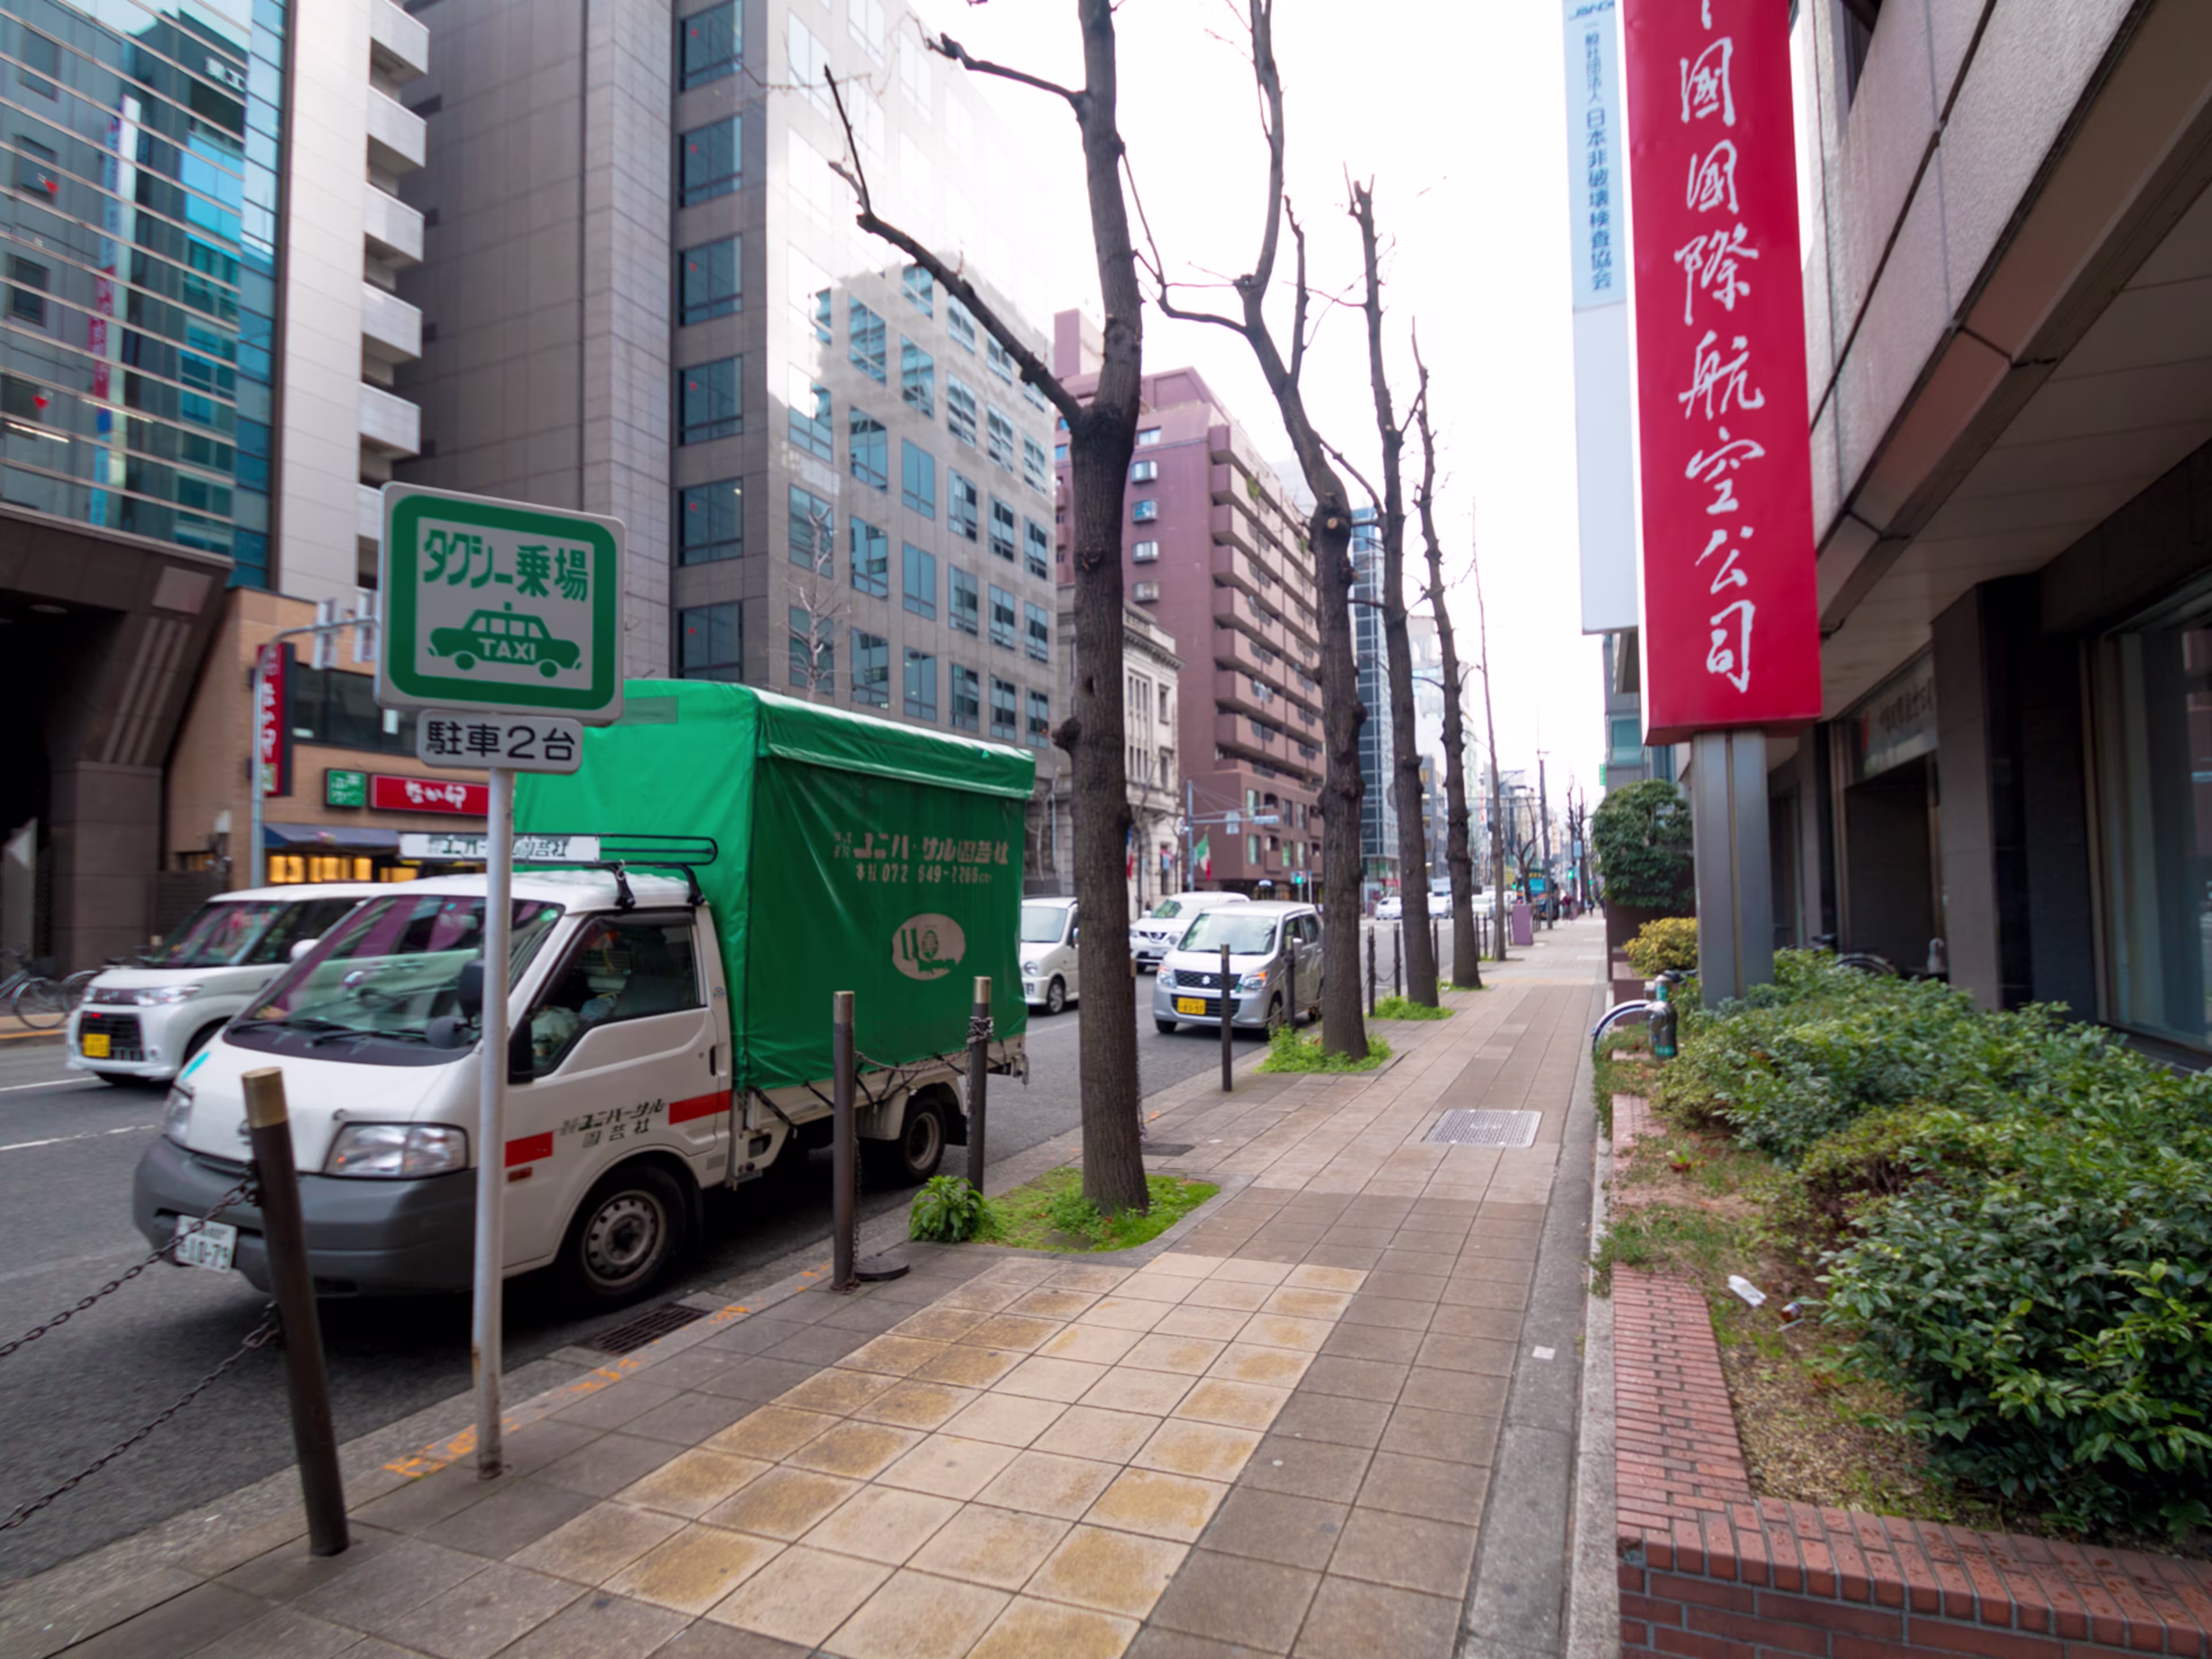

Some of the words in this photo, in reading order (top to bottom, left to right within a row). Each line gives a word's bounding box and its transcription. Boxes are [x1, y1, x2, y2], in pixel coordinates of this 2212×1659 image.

[1674, 0, 1766, 693] 國國際航空公司
[423, 528, 588, 602] タクシー乗場
[478, 637, 536, 661] TAXI
[426, 720, 575, 761] 駐車2台
